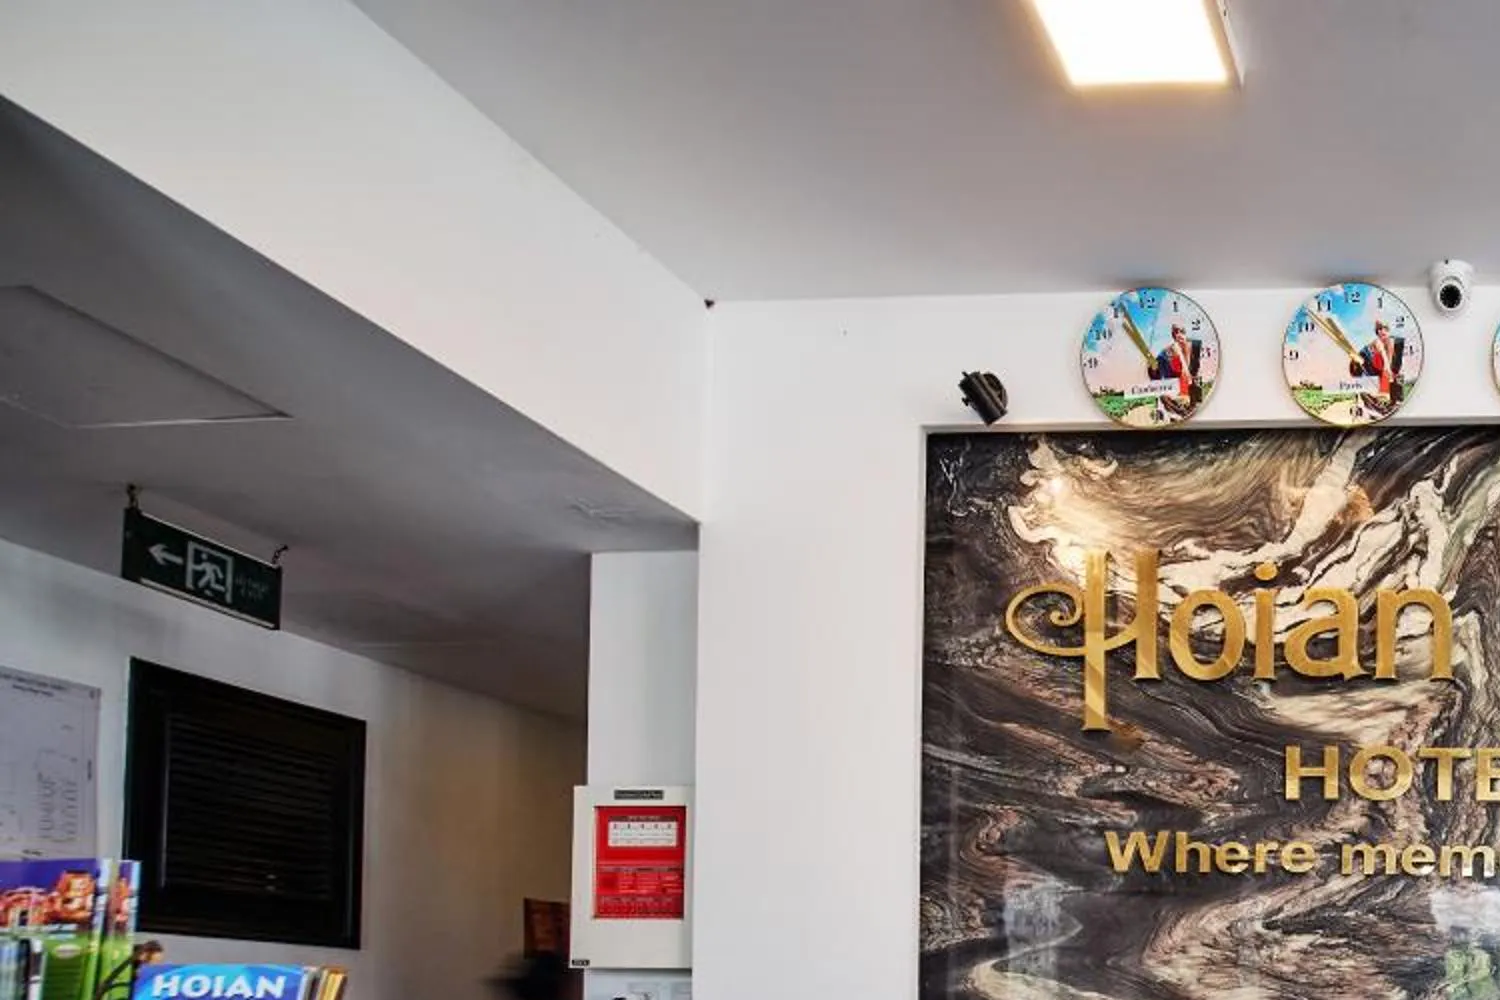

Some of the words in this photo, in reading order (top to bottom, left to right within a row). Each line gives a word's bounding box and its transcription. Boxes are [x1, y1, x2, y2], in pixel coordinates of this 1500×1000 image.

[1005, 549, 1454, 732] Hoian
[1104, 830, 1319, 875] Where
[151, 973, 288, 999] HOIAN
